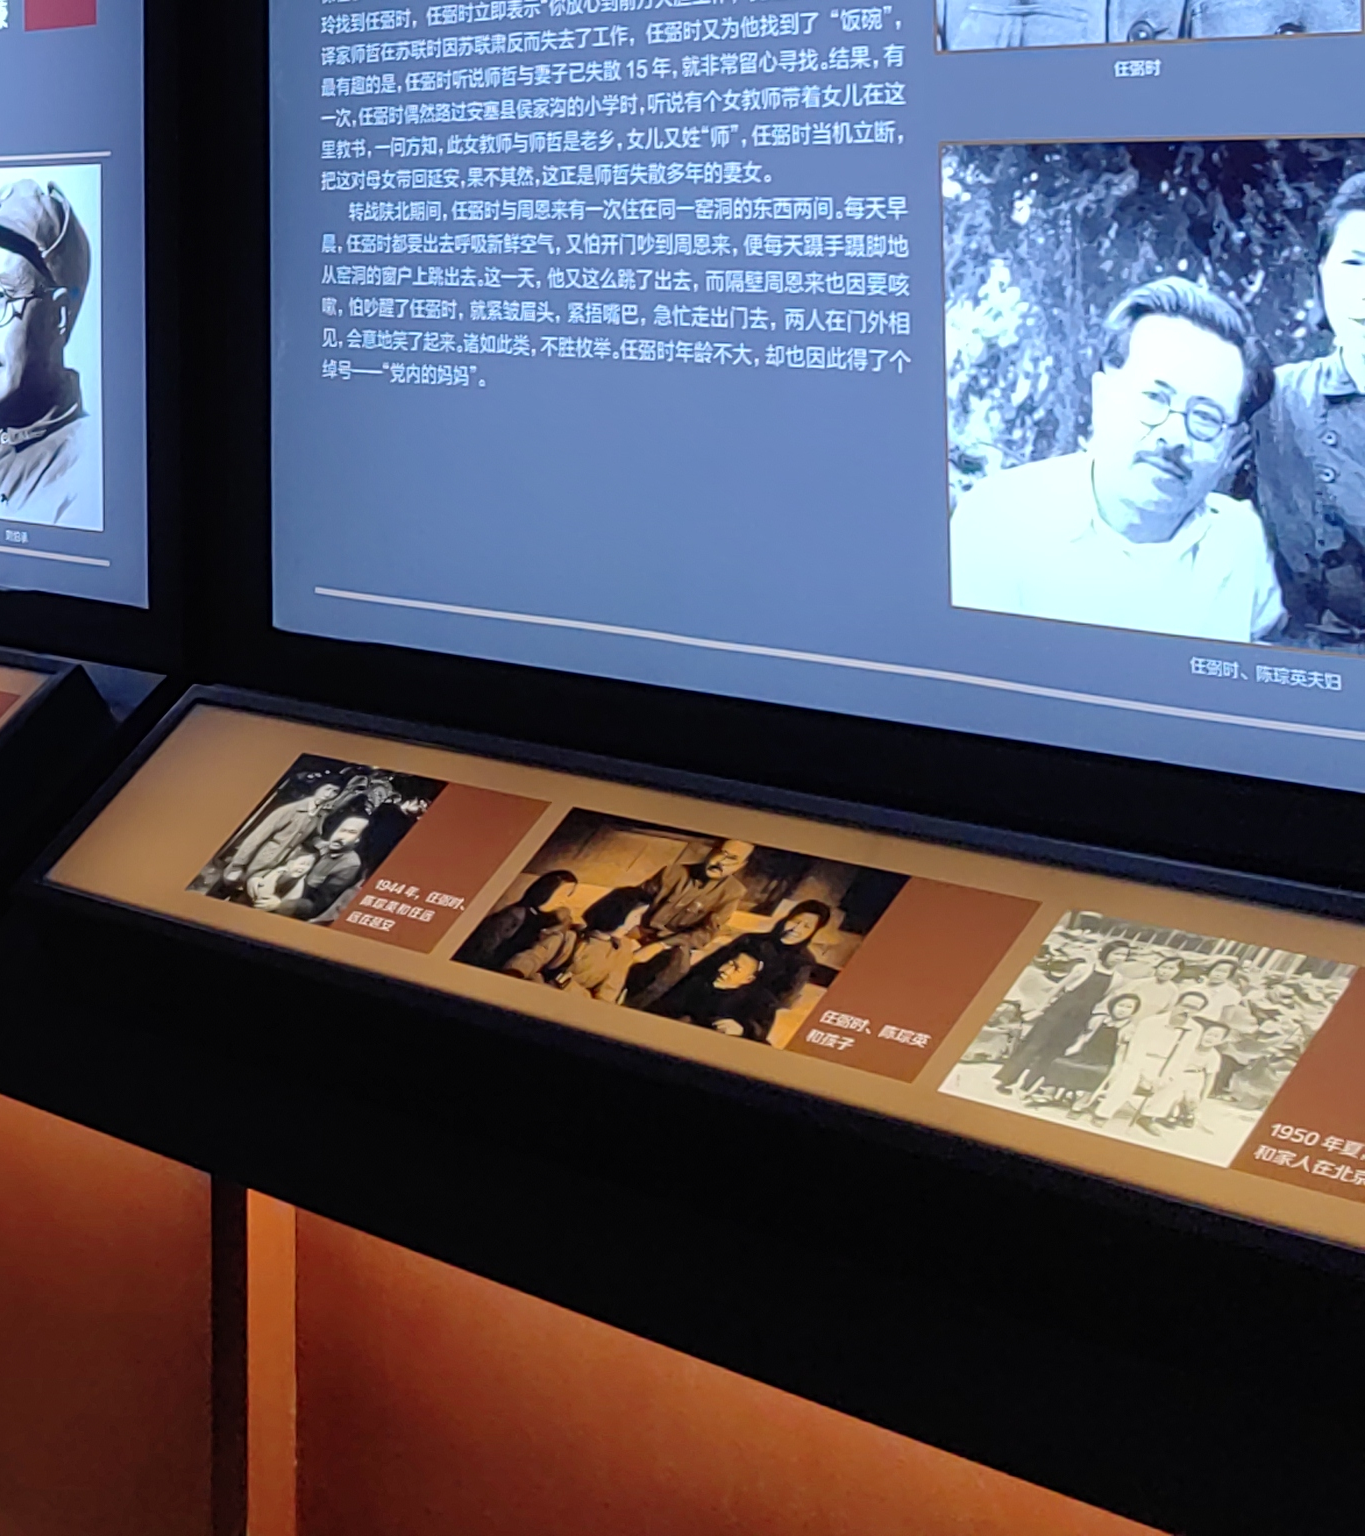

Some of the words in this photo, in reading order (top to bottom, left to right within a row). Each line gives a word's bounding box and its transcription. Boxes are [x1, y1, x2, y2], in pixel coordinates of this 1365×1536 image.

[1113, 58, 1162, 79] 任弼时
[1189, 654, 1343, 692] 任弼时、陈琮英夫妇
[804, 1028, 855, 1053] 和孩子
[819, 1009, 933, 1049] 任弼时、陈琮英
